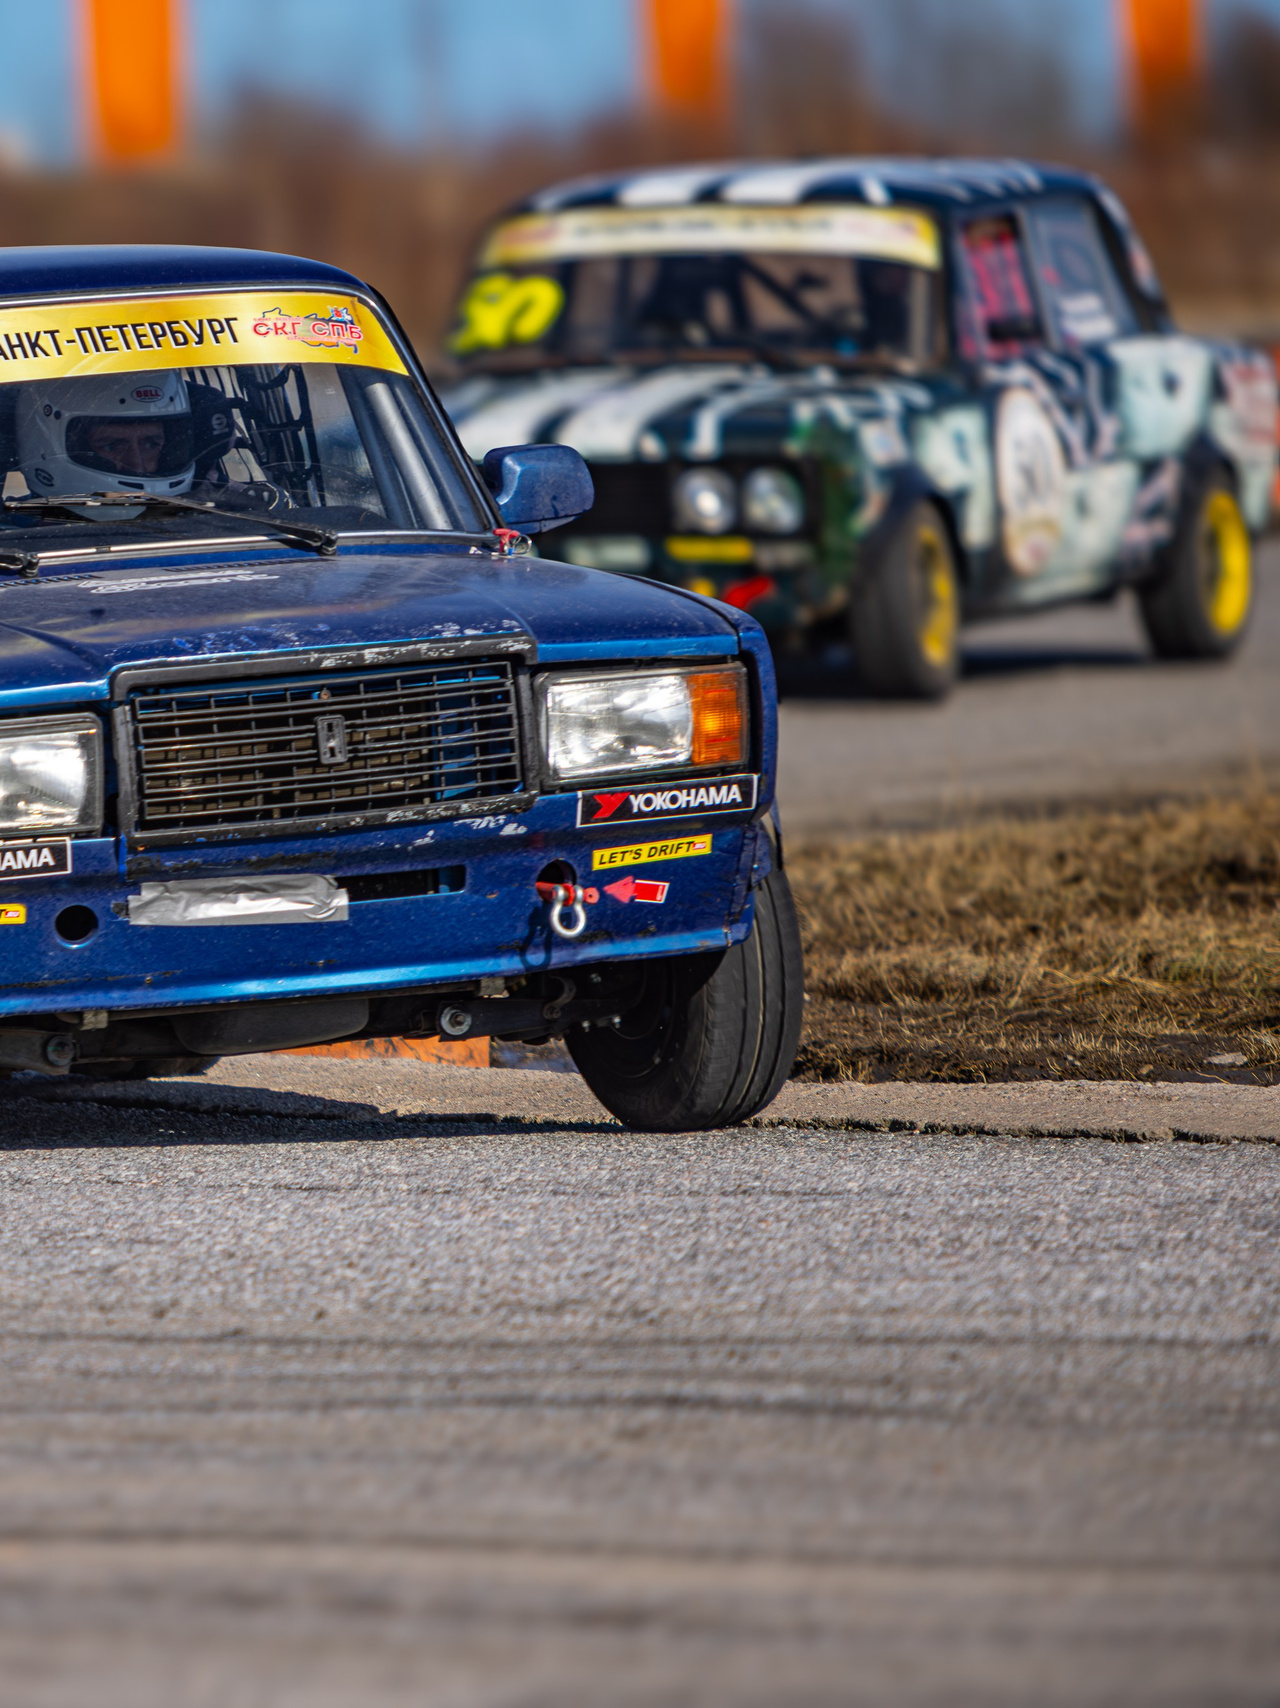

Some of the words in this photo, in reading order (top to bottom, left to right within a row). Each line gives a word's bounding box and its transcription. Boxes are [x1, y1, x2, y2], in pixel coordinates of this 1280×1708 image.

[252, 321, 301, 336] СКГ
[310, 321, 363, 340] СПБ
[135, 390, 161, 398] BELL
[629, 784, 742, 813] YOKOHAMA
[598, 847, 642, 865] LET'S
